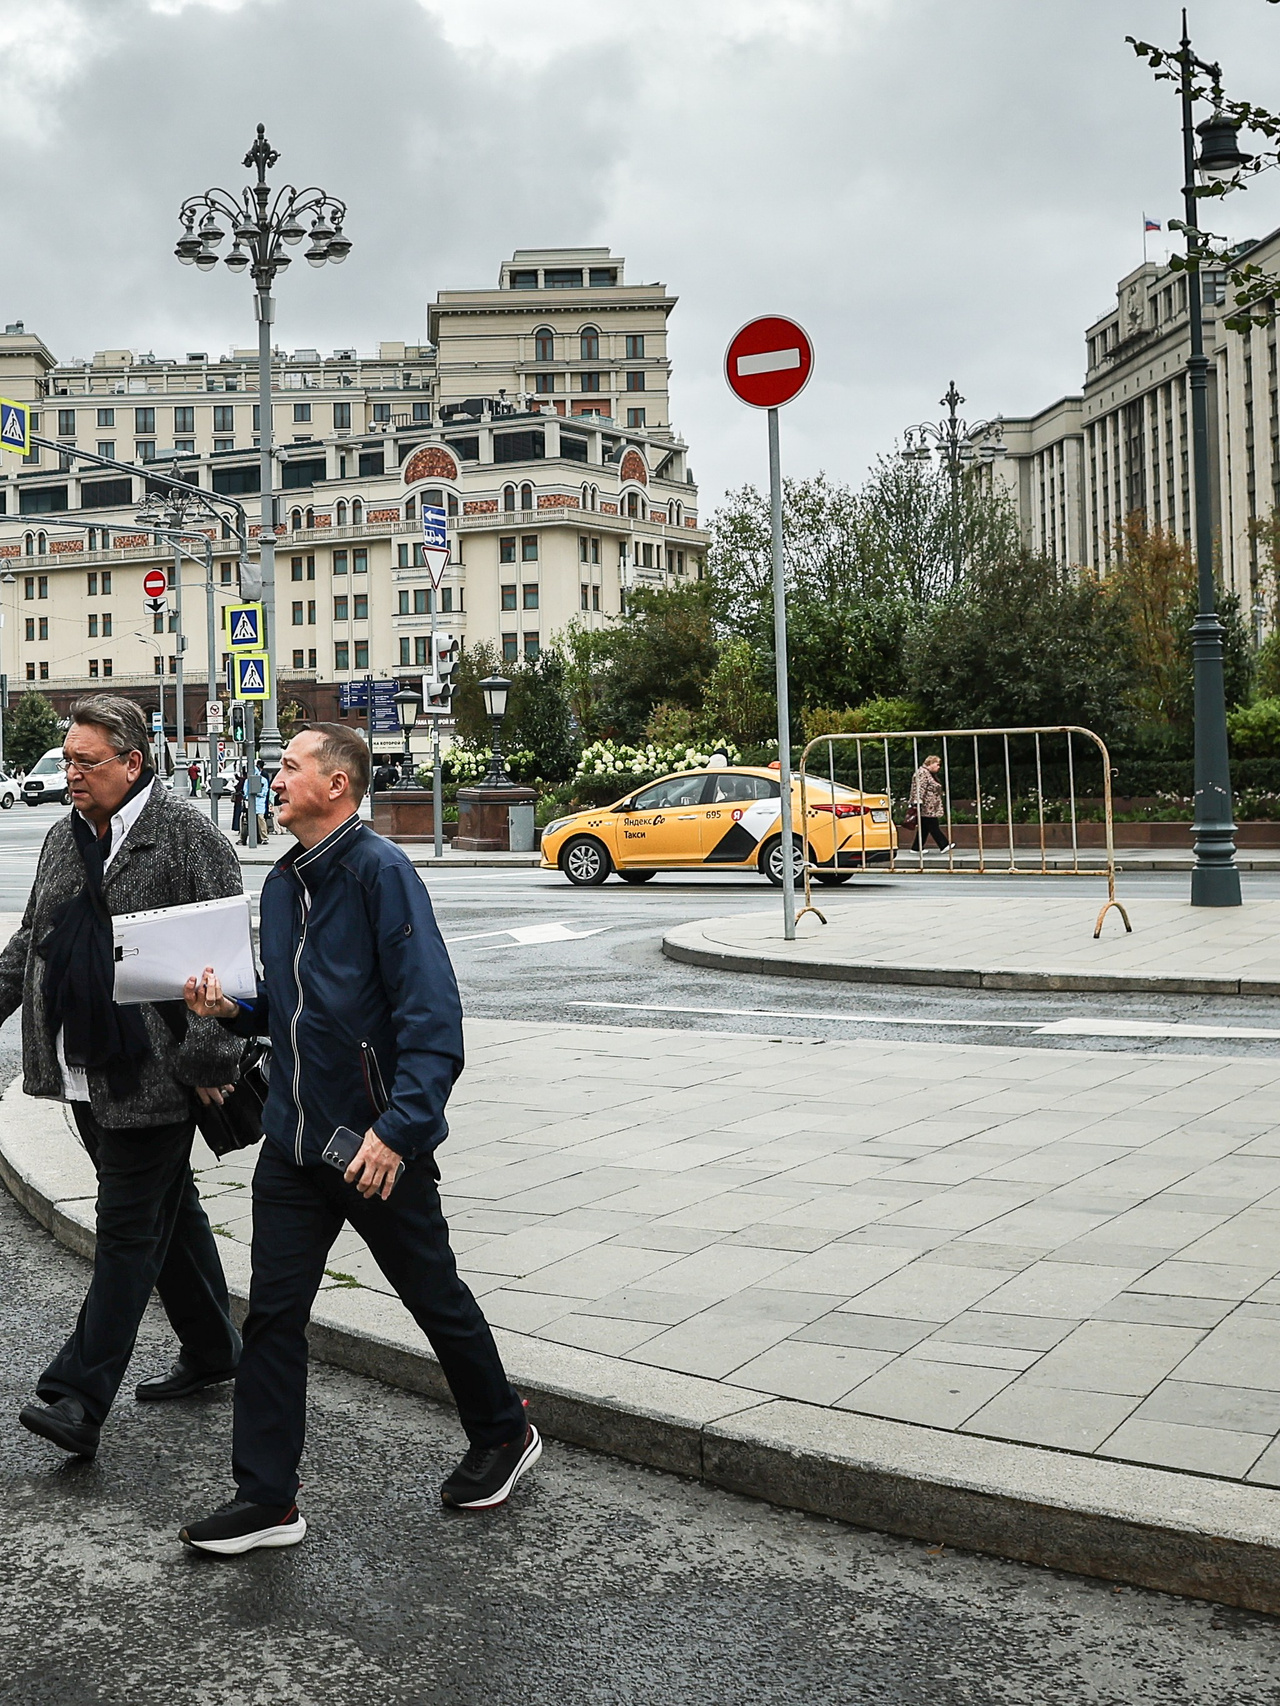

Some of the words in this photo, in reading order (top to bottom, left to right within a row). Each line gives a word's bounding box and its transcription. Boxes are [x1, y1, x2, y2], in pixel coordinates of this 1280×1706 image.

[705, 810, 722, 819] 695
[732, 810, 741, 820] Я
[624, 818, 652, 827] Яндекс
[652, 814, 666, 827] Go
[624, 831, 646, 839] Такси
